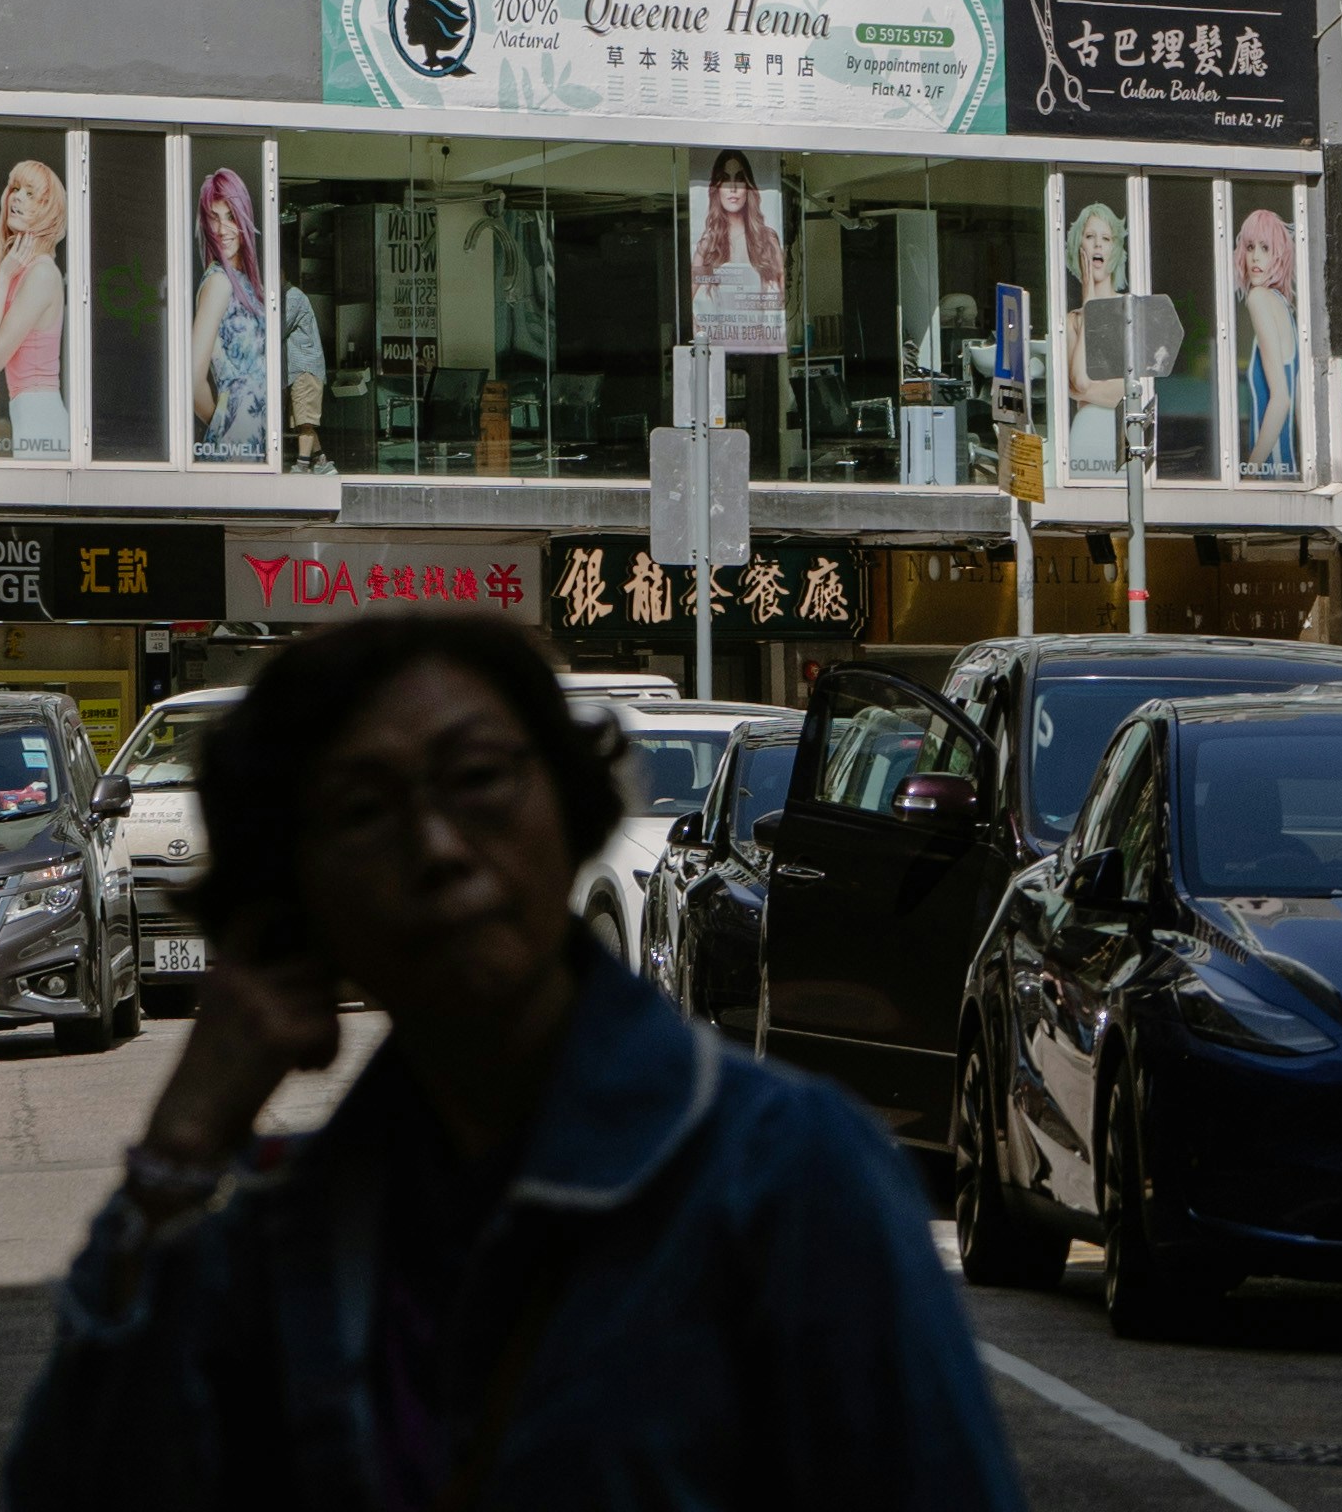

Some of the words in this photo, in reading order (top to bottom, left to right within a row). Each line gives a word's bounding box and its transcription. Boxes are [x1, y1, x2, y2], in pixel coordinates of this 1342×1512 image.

[493, 30, 560, 50] Natural
[879, 28, 910, 43] 5975
[912, 28, 944, 45] 9752
[1067, 20, 1269, 78] 古巴理髮廳
[606, 45, 815, 78] 草本染髮專門店
[846, 55, 861, 75] By
[863, 56, 940, 76] appointment
[942, 60, 968, 78] only
[871, 82, 894, 97] Flat
[897, 83, 911, 97] A2
[924, 85, 946, 99] 2/F
[1120, 77, 1167, 100] Cuban
[1170, 79, 1221, 102] Barber
[1215, 111, 1237, 127] Flat
[1239, 113, 1254, 127] A2
[1264, 114, 1284, 129] 2/F
[1002, 294, 1019, 370] P
[193, 442, 265, 458] GOLDWELL
[1239, 461, 1300, 476] GOLDWELL
[80, 547, 149, 595] 汇款
[1033, 555, 1129, 584] TAILO
[558, 547, 849, 626] 銀龍茶餐廳
[169, 940, 189, 956] RK
[159, 955, 201, 971] 3804
